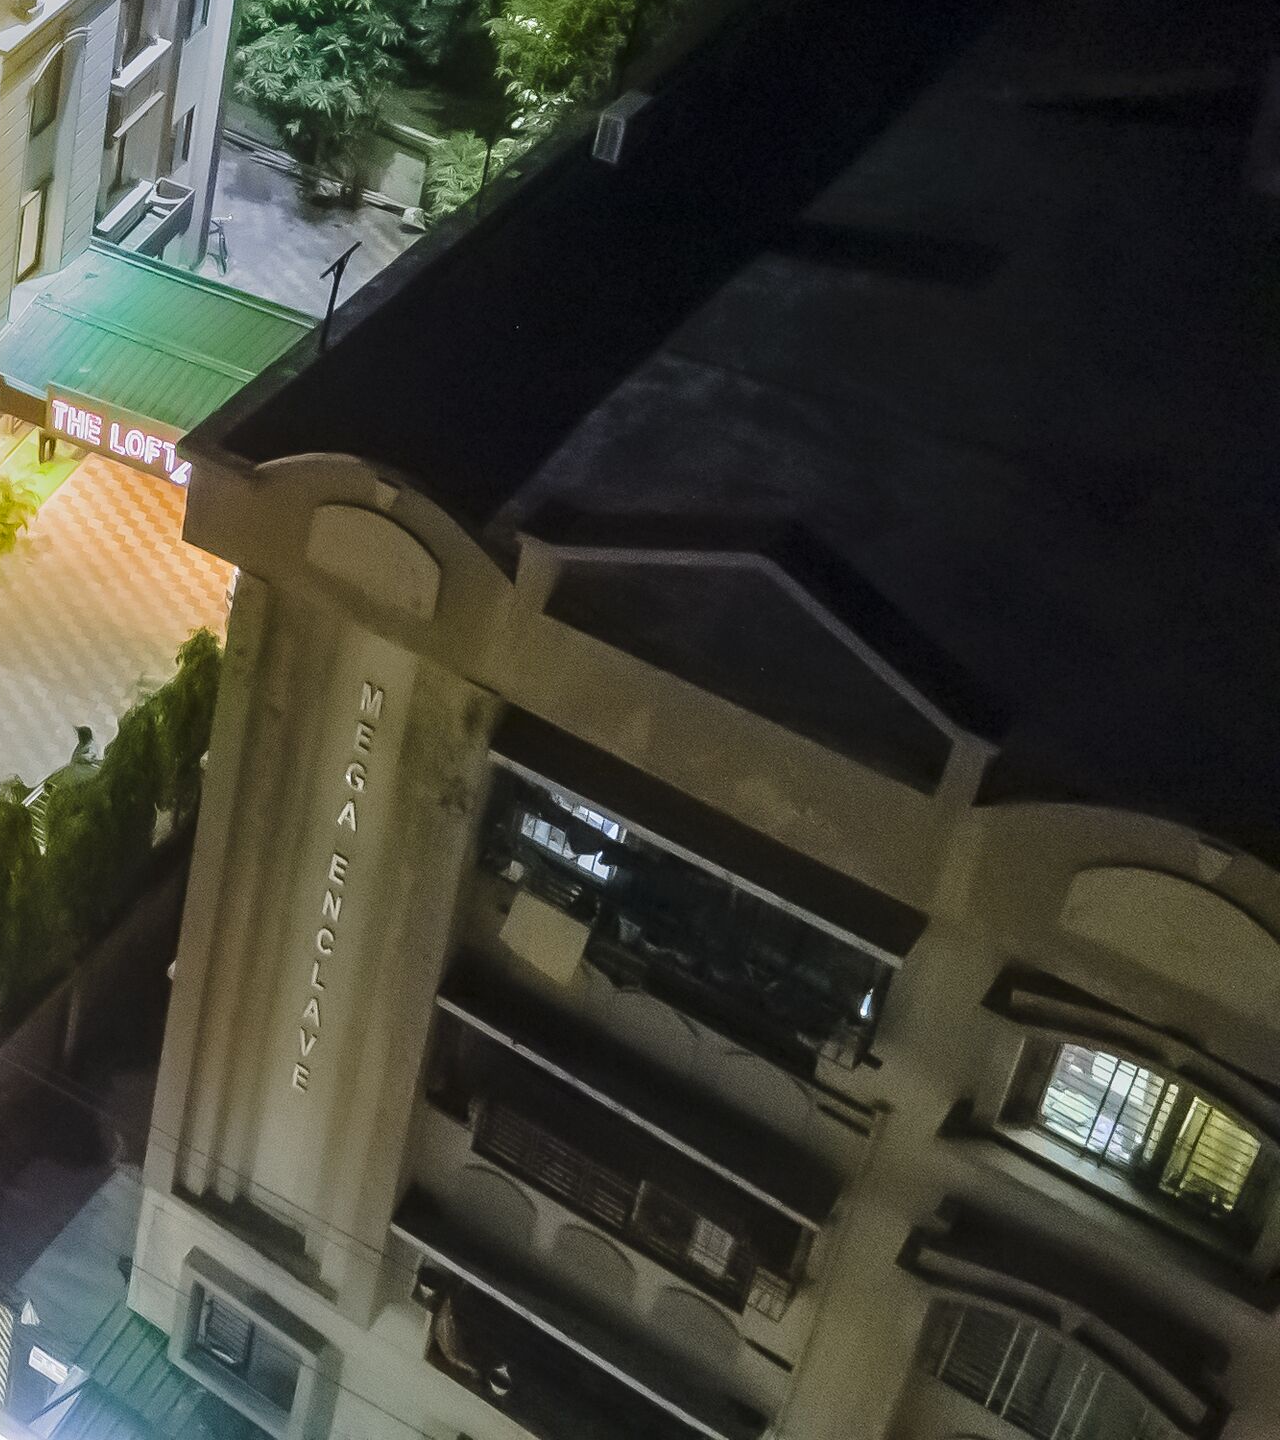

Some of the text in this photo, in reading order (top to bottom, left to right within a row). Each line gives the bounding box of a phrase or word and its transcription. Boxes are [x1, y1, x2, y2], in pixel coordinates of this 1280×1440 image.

[51, 399, 176, 473] THE LOFT
[292, 681, 384, 1093] MEGA ENCLAVE
